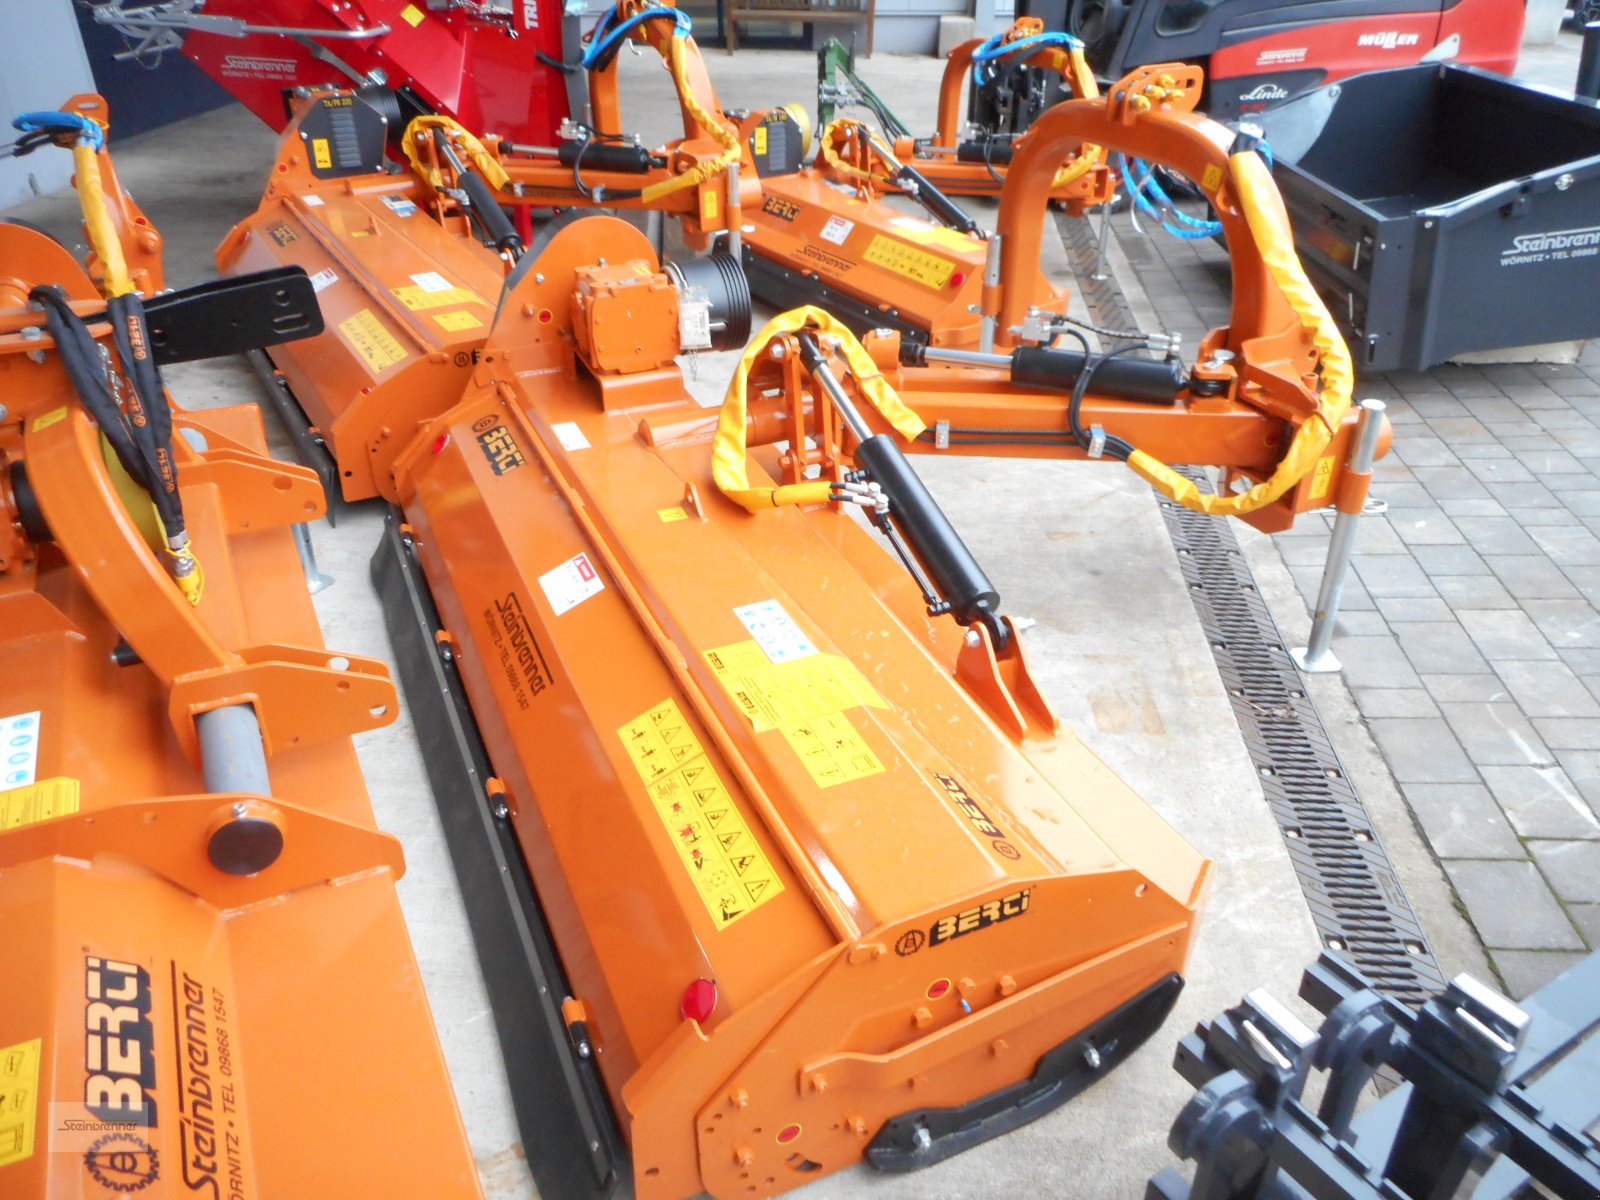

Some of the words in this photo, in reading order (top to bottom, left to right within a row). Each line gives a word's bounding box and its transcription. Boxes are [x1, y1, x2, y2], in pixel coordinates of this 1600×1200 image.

[1357, 31, 1420, 49] MÜLLER
[1239, 84, 1288, 100] Linde
[1552, 252, 1569, 260] TEL
[495, 592, 554, 697] Steinbrenner
[212, 986, 226, 1022] 1547
[216, 1028, 232, 1077] 09868
[171, 960, 219, 1200] Steinbrenner
[221, 1082, 236, 1114] TEL
